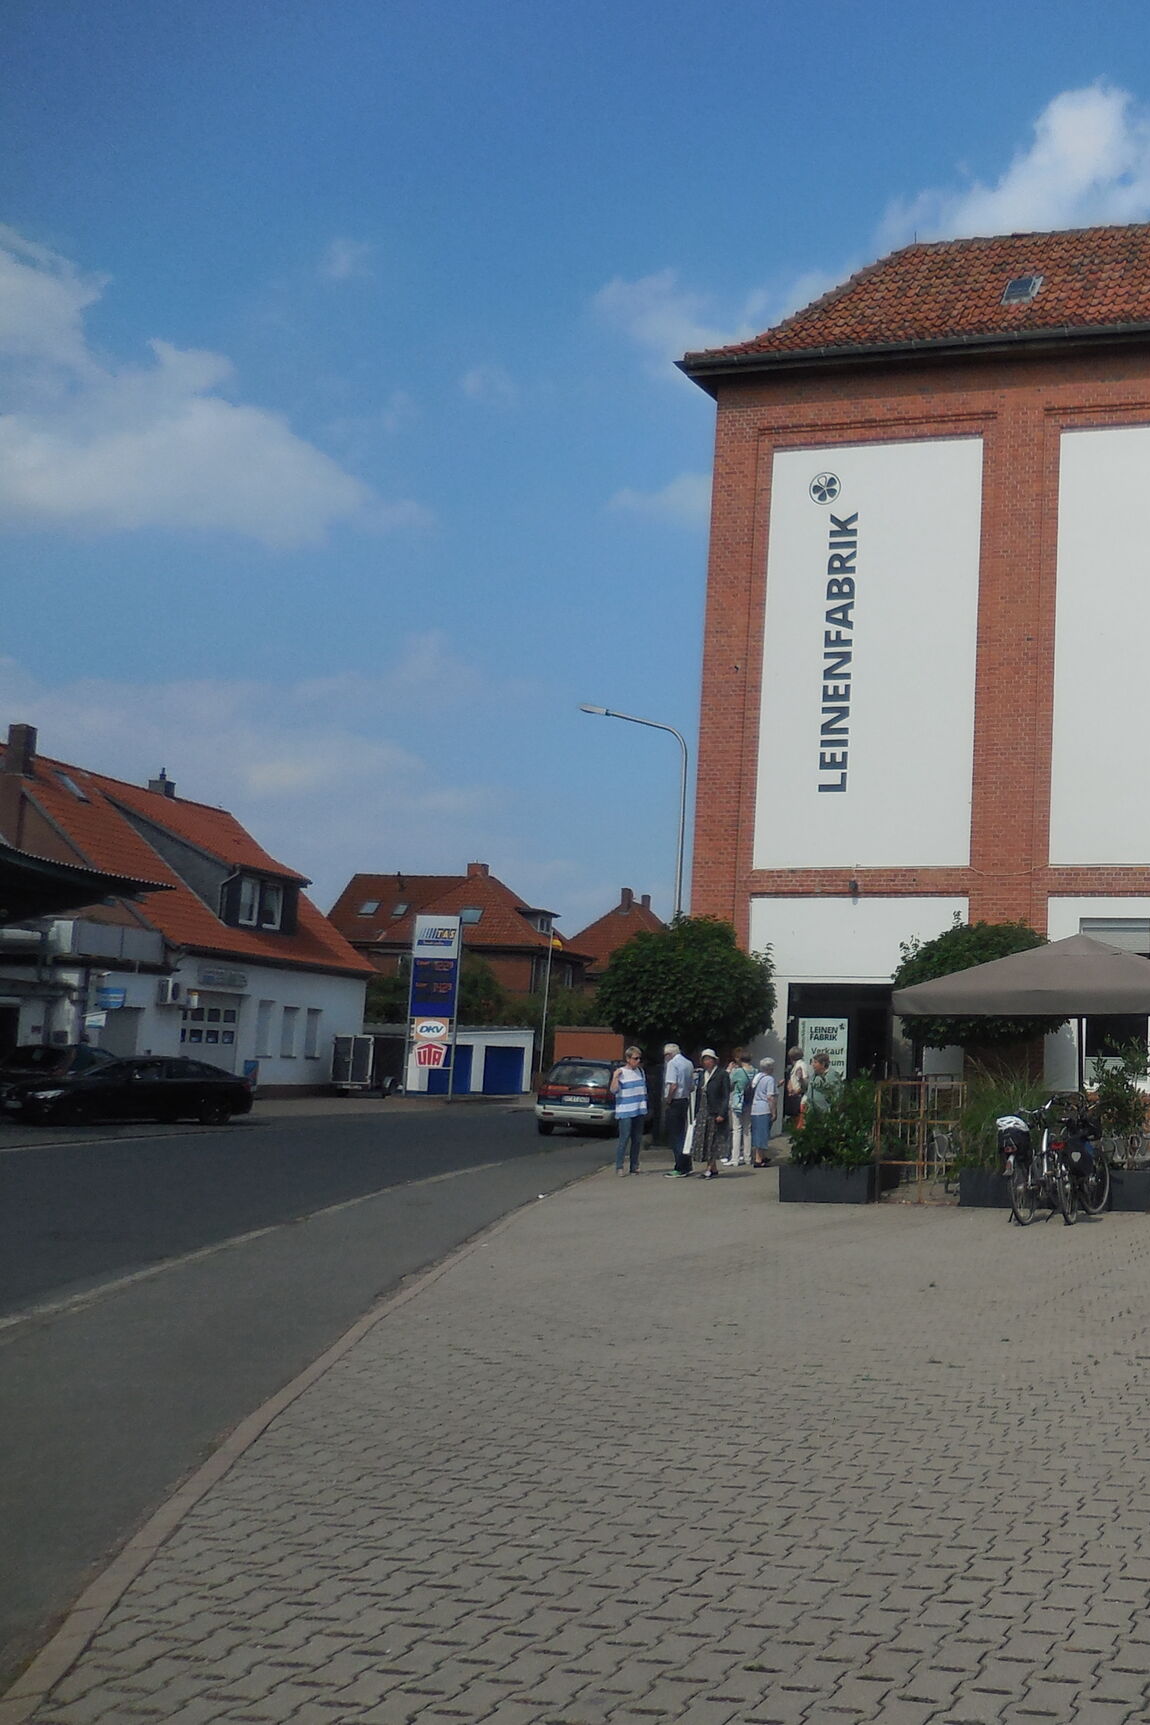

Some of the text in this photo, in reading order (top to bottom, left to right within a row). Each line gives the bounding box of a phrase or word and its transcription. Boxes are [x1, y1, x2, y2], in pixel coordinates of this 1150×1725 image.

[818, 511, 858, 792] LEINENFABRIK
[437, 929, 456, 939] TAS
[419, 1025, 444, 1033] DKV
[417, 1043, 443, 1065] UTA
[811, 1047, 844, 1055] Verkauf
